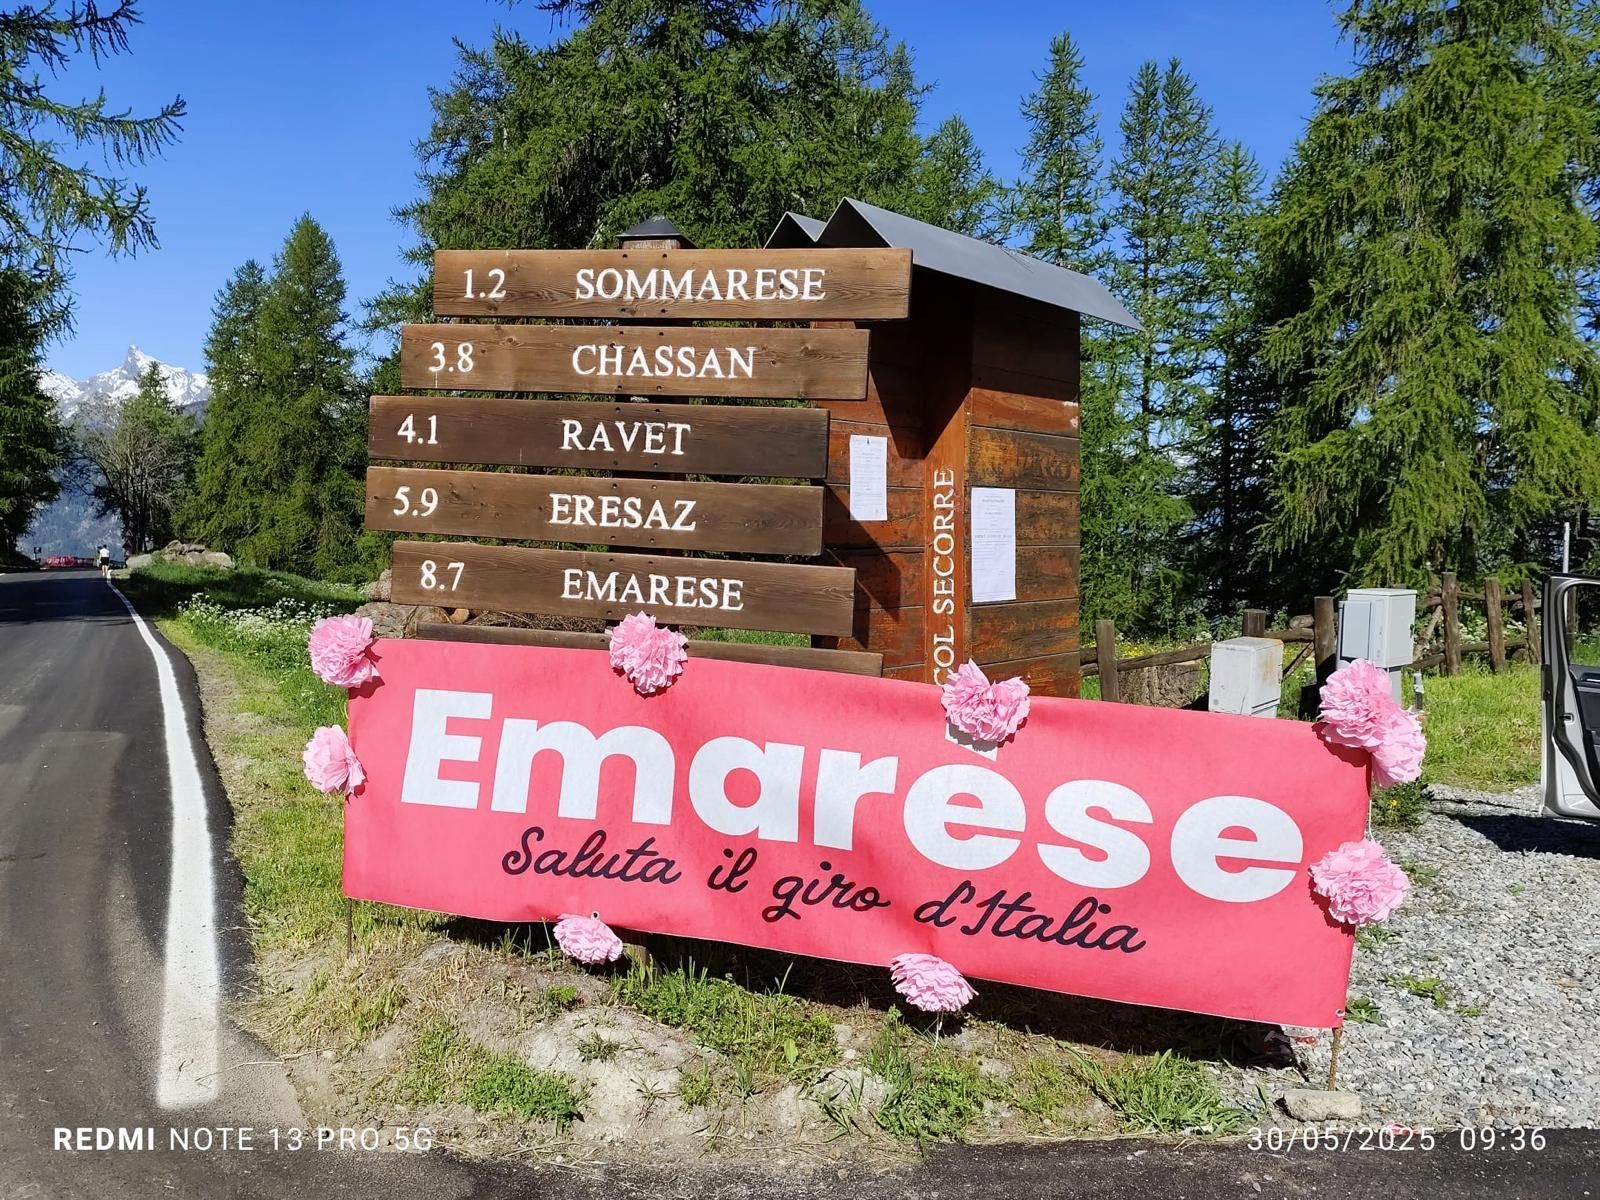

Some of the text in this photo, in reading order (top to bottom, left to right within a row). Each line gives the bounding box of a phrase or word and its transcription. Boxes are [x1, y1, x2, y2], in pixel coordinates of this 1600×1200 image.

[463, 267, 827, 303] 1.2 SOMMARESE
[428, 341, 757, 379] 3.8 CHASSAN
[397, 413, 691, 456] 4.1 RAVET
[392, 486, 697, 532] 5.9 ERESAZ
[419, 559, 744, 612] 8.7 EMARESE
[932, 468, 956, 687] COL SECORRE
[400, 688, 1304, 904] Emarèse
[501, 826, 1147, 954] Saluta il giro d'Italia
